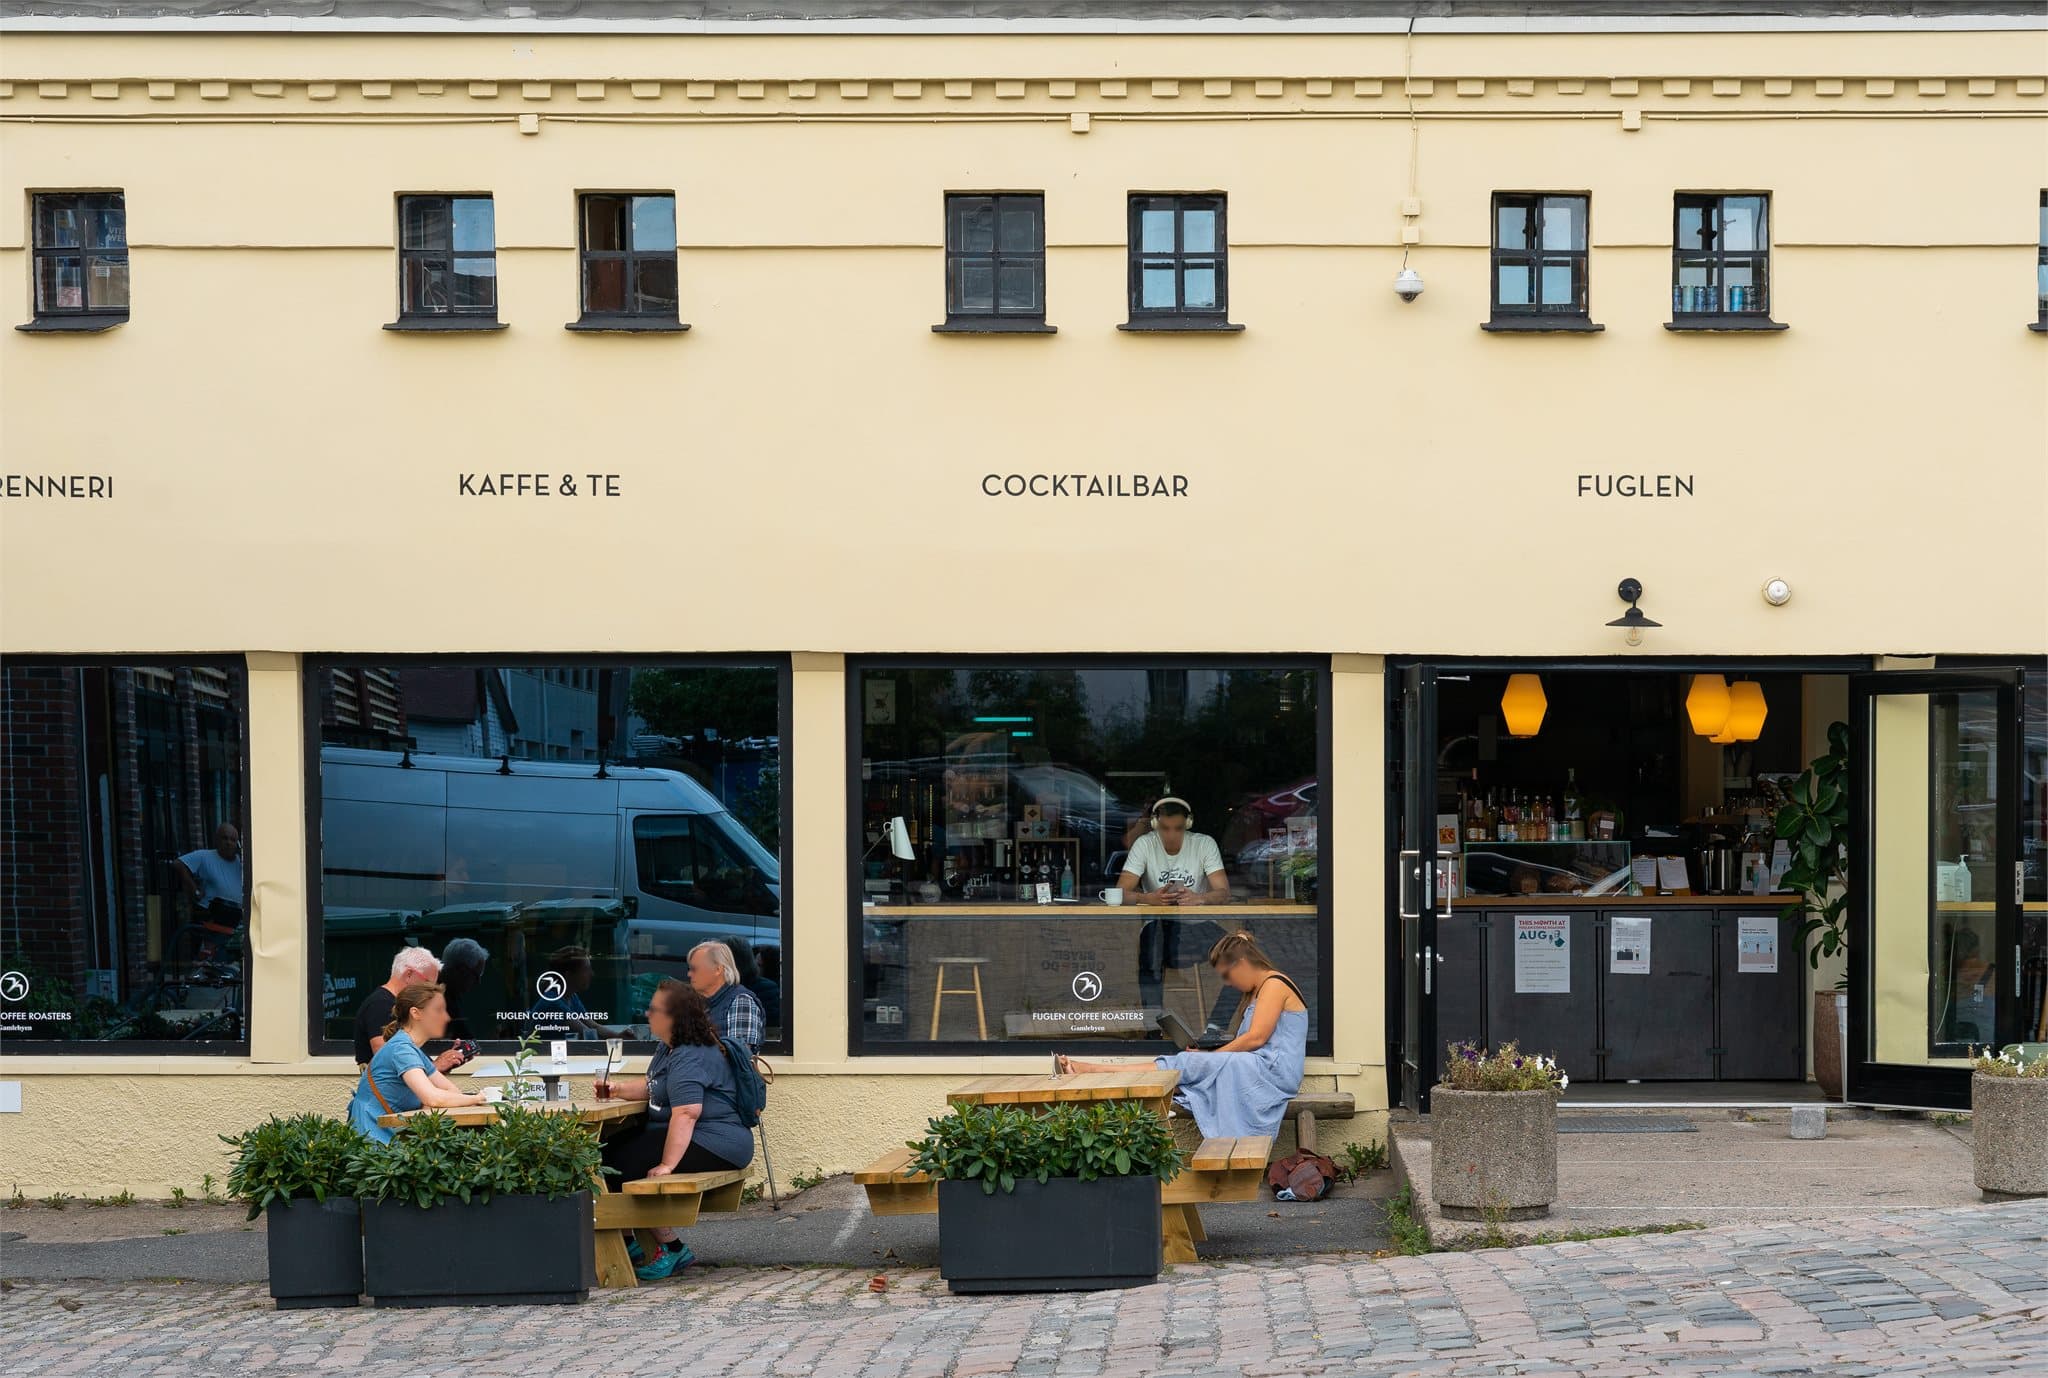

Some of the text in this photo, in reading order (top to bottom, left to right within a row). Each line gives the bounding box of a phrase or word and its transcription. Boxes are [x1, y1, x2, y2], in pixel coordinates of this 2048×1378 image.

[0, 475, 113, 498] ENNERI
[460, 474, 620, 497] KAFFE & TE
[983, 475, 1188, 497] COCKTAILBAR
[1579, 475, 1694, 497] FUGLEN
[1519, 930, 1547, 940] AUG
[0, 1011, 72, 1021] OFFEE ROASTERS
[496, 1011, 609, 1021] FUGLEN COFFEE ROASTERS
[1032, 1012, 1144, 1021] FUGLEN COFFEE ROASTERS
[534, 1024, 570, 1034] Gamlebyen
[1070, 1024, 1105, 1033] Gamlebyen
